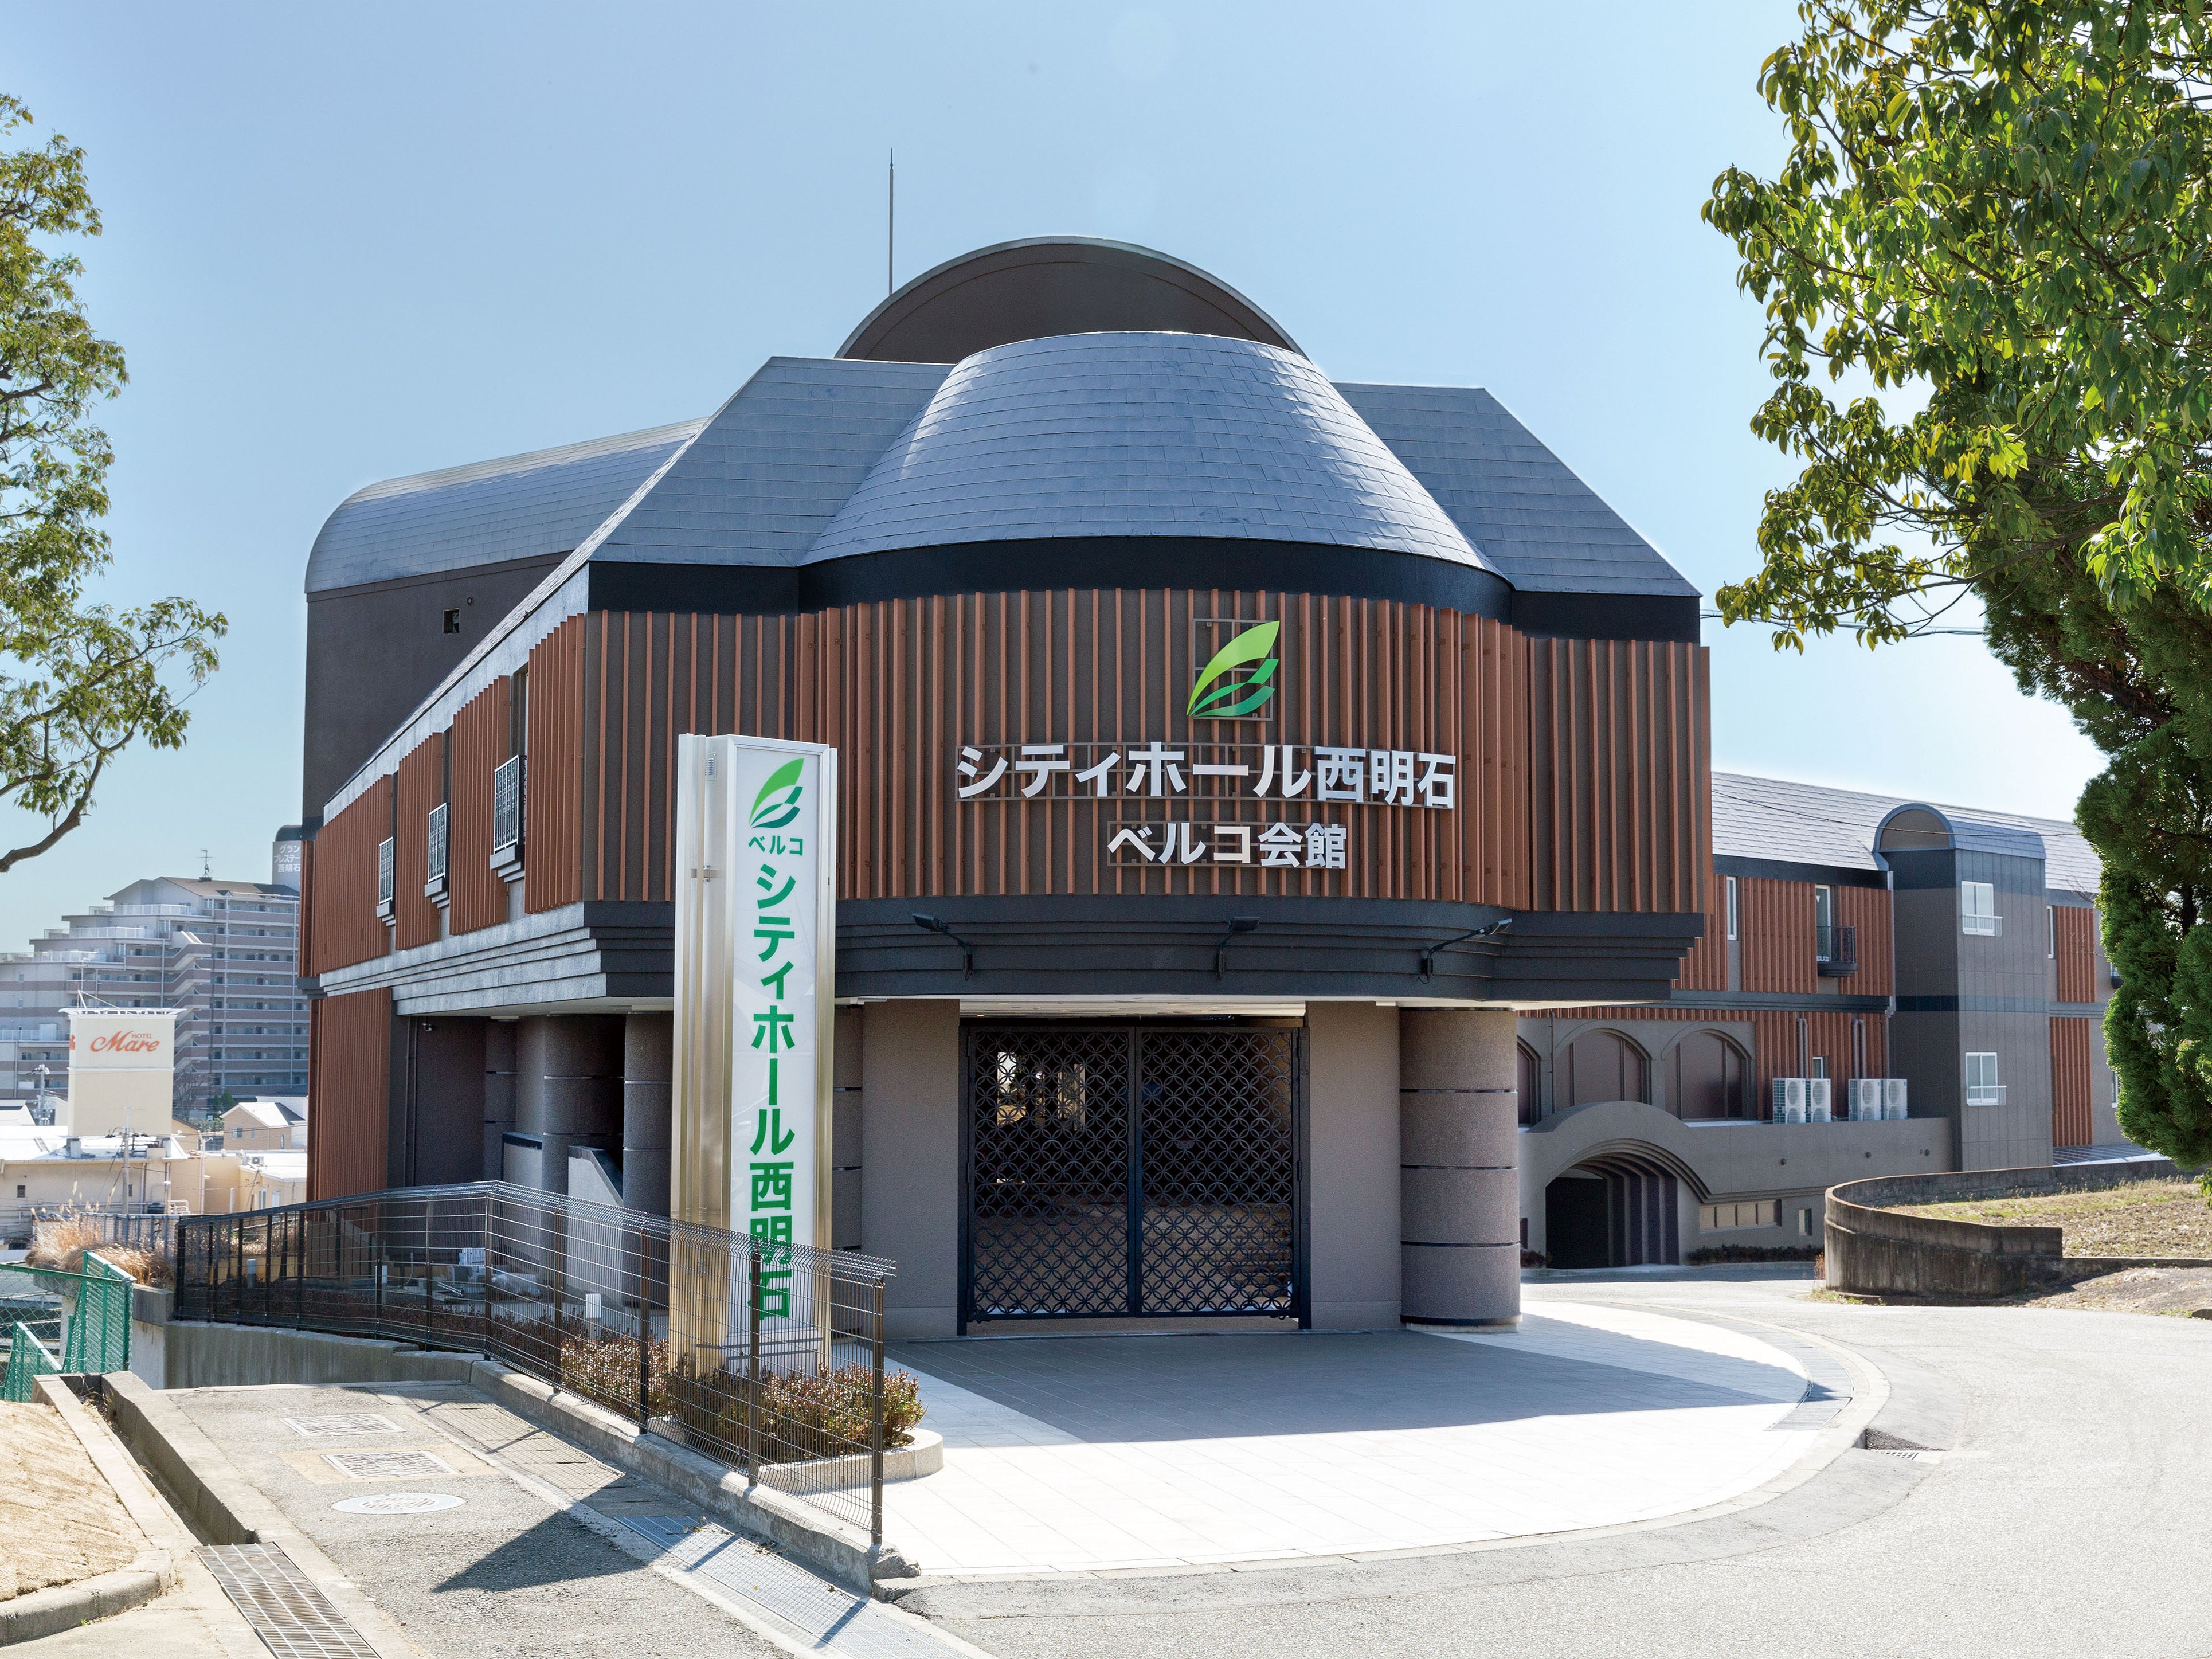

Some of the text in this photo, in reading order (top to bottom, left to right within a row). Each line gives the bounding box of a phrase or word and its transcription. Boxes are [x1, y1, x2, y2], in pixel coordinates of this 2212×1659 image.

[957, 741, 1456, 809] シティホール西明石
[279, 844, 300, 854] グラン
[749, 835, 803, 856] ベルコ
[1107, 823, 1346, 870] ベルコ会館
[277, 863, 301, 872] 西明石
[90, 1031, 160, 1052] Mare
[747, 863, 796, 1321] シティホール西明石
